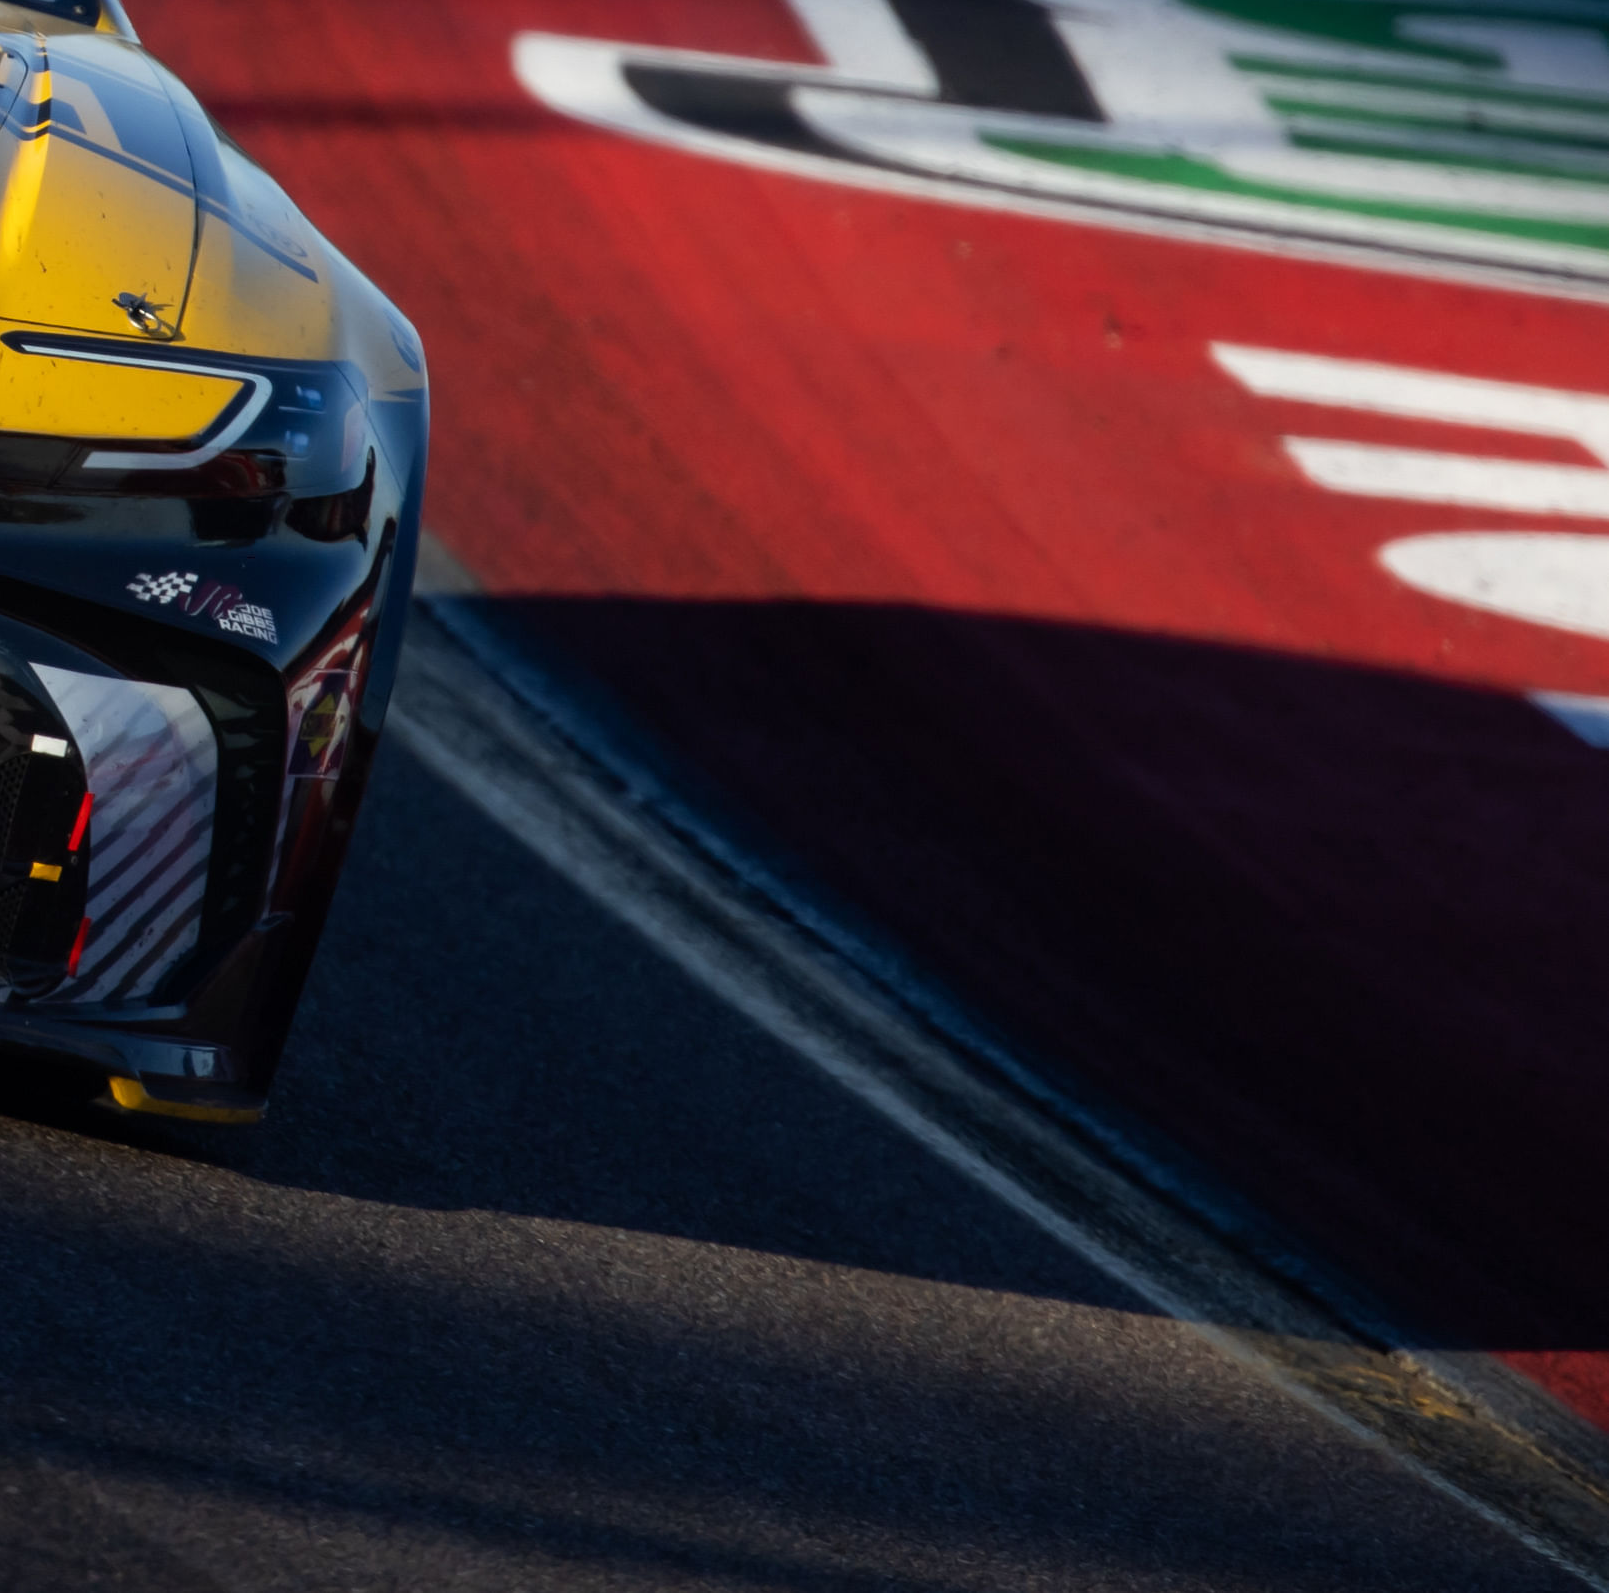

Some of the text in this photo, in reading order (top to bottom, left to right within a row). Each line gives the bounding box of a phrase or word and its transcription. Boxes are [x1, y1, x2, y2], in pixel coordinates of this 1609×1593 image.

[227, 609, 277, 632] GIBBS
[238, 602, 274, 619] JOE
[218, 618, 279, 646] RACING
